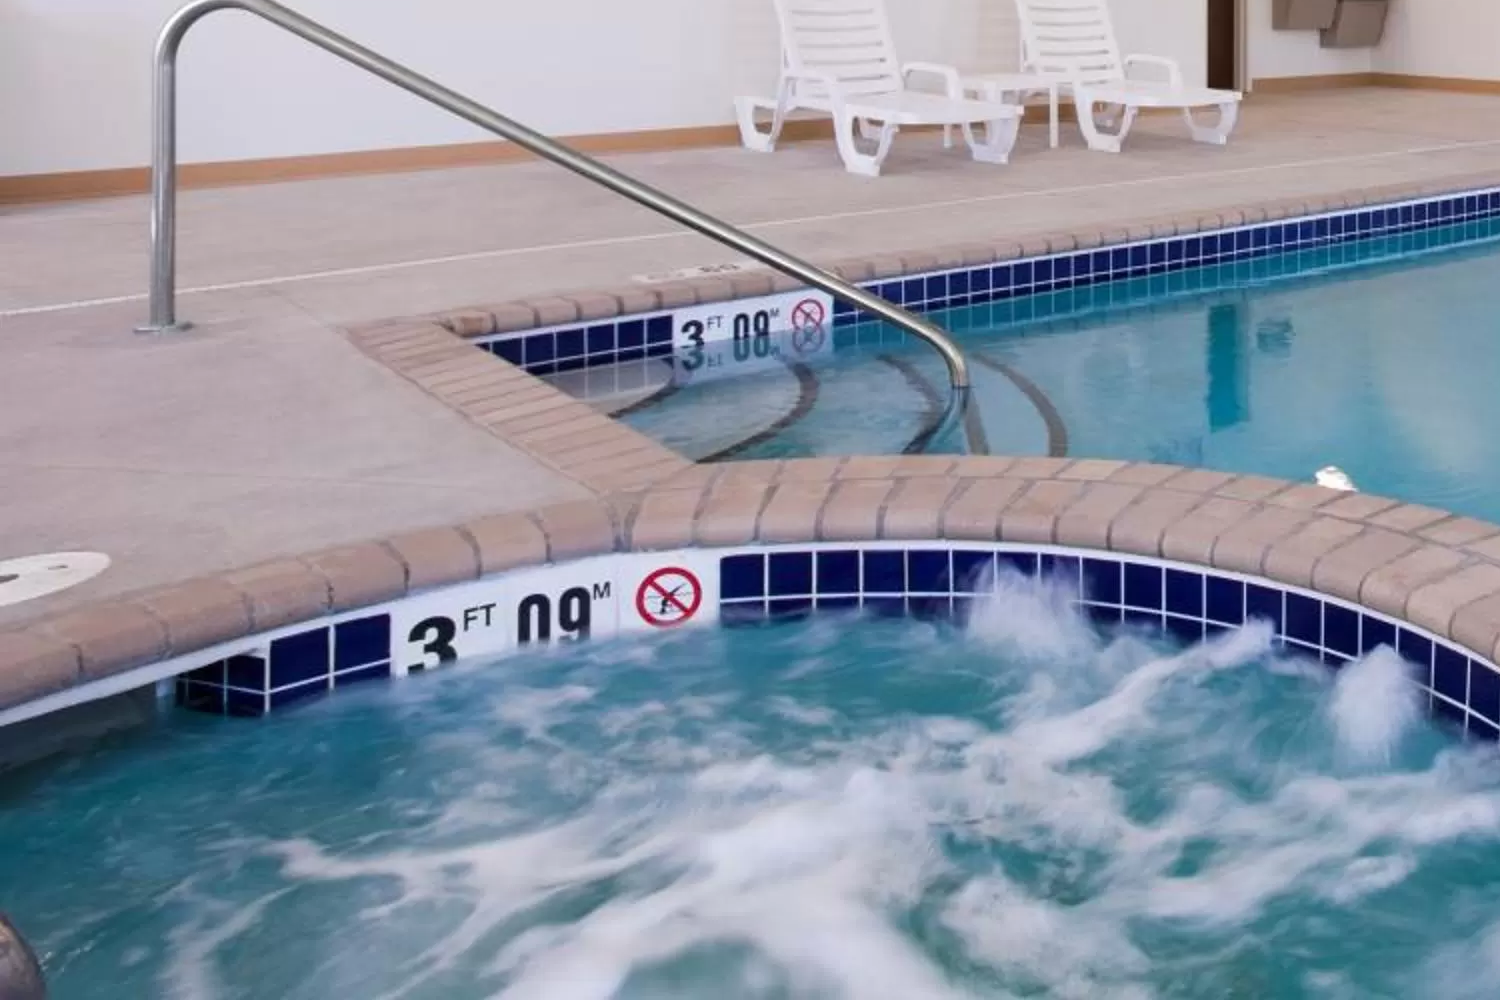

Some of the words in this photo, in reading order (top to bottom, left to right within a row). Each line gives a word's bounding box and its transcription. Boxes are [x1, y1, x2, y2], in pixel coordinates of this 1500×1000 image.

[681, 319, 704, 348] 3
[407, 616, 457, 675] 3
[463, 603, 497, 631] FT
[593, 582, 611, 600] M
